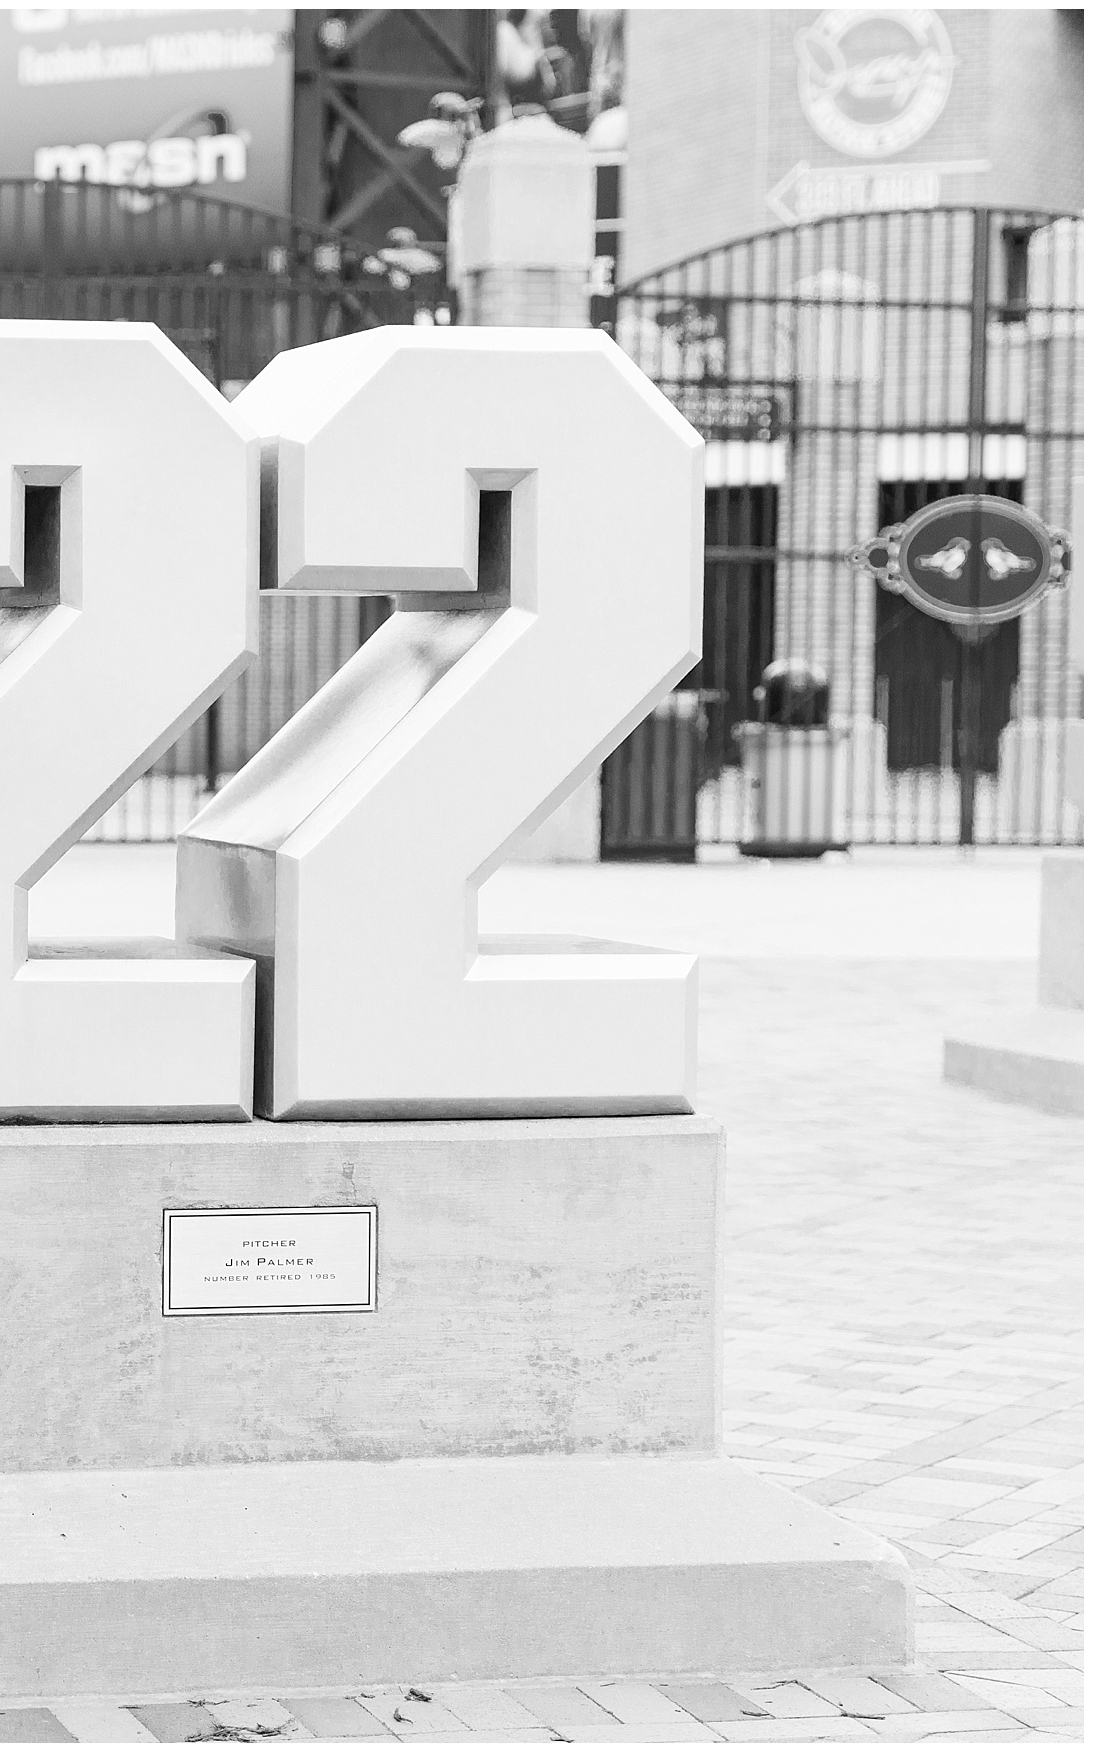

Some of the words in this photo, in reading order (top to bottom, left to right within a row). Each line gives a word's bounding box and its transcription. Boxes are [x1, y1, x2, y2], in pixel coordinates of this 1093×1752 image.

[242, 1239, 297, 1248] PITCHER
[204, 1274, 250, 1282] NUMBER
[256, 1273, 302, 1281] RETIRED
